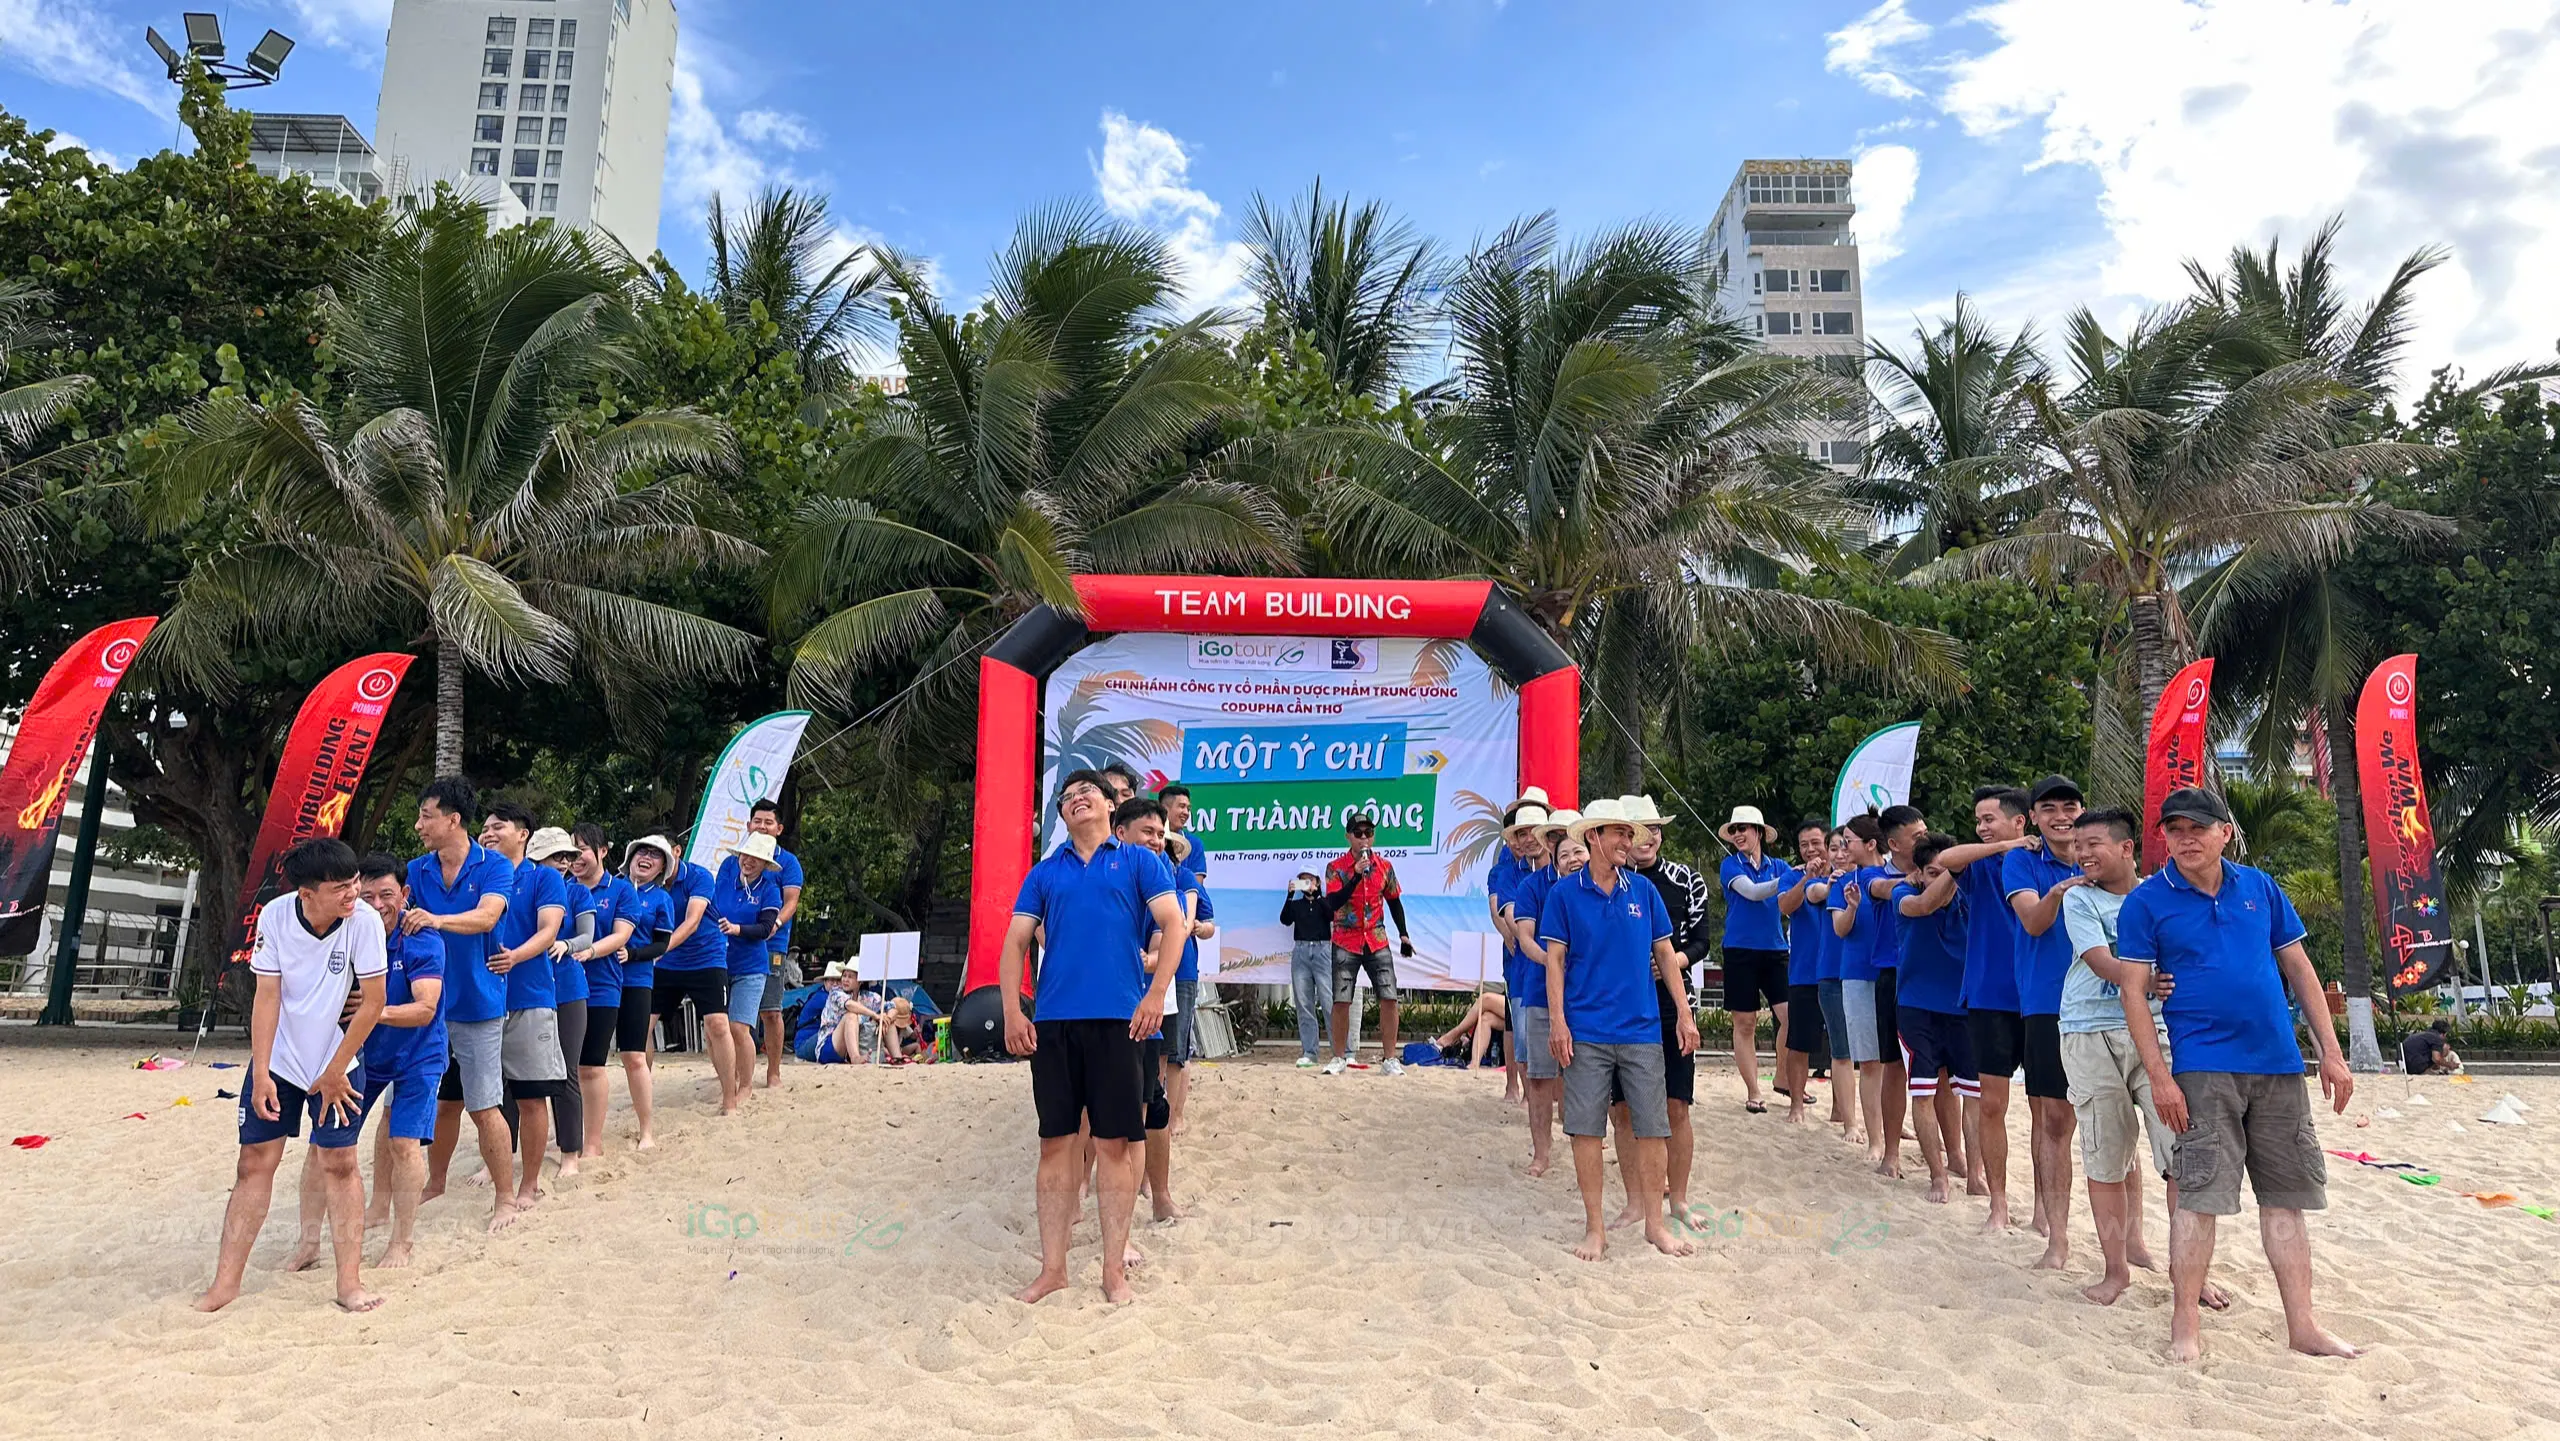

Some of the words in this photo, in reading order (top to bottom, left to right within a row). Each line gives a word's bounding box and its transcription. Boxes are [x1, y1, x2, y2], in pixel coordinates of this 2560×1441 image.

[1154, 590, 1246, 616] TEAM
[1265, 592, 1412, 620] BUILDING
[1198, 640, 1277, 658] iGotour
[1105, 679, 1127, 690] CHI
[1128, 677, 1178, 691] NHÁNH
[1180, 679, 1215, 693] CÔNG
[1218, 683, 1233, 693] TY
[1234, 677, 1252, 694] CỔ
[1254, 678, 1290, 695] PHẦN
[1293, 685, 1331, 699] DƯỢC
[1332, 680, 1370, 696] PHẨM
[1373, 686, 1417, 697] TRUNG
[1419, 686, 1458, 698] ƯƠNG
[351, 701, 384, 716] POWER
[1221, 702, 1285, 713] CODUPHA
[1287, 697, 1314, 714] CẦN
[1315, 703, 1343, 714] THƠ
[332, 724, 373, 795] EVENT
[1195, 733, 1281, 778] MỘT
[1290, 733, 1316, 770] Ý
[1325, 733, 1390, 771] CHÍ
[2167, 733, 2180, 769] We
[2379, 729, 2396, 769] We
[2179, 757, 2195, 787] IN
[2397, 756, 2417, 808] WIN
[1227, 799, 1333, 832] THÀNH
[1340, 797, 1424, 832] CÔNG
[1214, 852, 1236, 861] Nha
[1238, 852, 1271, 863] Trang,
[1272, 852, 1298, 862] ngày
[1301, 851, 1314, 859] 05
[1383, 849, 1408, 858] 2025
